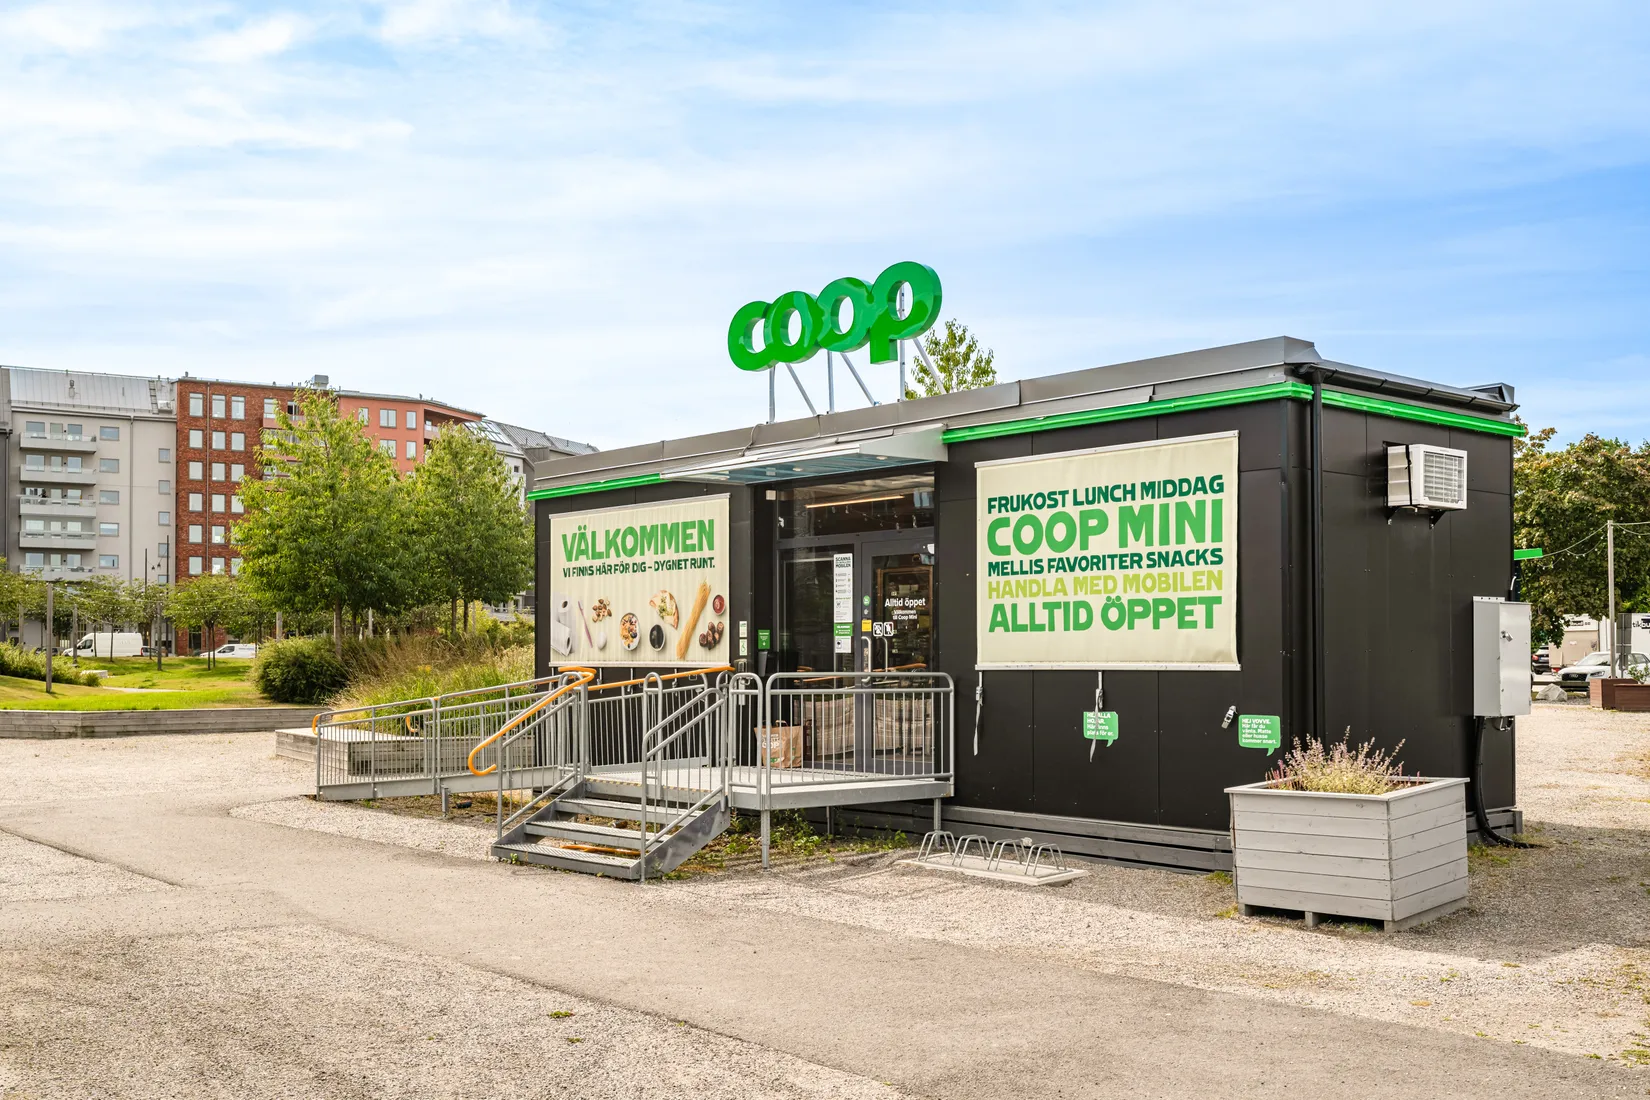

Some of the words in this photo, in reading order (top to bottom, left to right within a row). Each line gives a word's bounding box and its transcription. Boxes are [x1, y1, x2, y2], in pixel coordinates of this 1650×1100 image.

[728, 261, 942, 372] coop
[988, 490, 1069, 514] FRUKOST
[1073, 483, 1136, 507] LUNCH
[1140, 474, 1224, 500] MIDDAG
[561, 519, 715, 562] VÄLKOMMEN
[987, 508, 1109, 556] COOP
[1118, 498, 1223, 548] MINI
[563, 566, 571, 578] VI
[572, 565, 594, 577] FINNS
[595, 562, 612, 576] HÄR
[613, 561, 630, 575] FÖR
[632, 561, 647, 573] DIG
[654, 558, 689, 572] DYGNET
[690, 557, 715, 570] RUNT.
[988, 558, 1044, 577] MELLIS
[1047, 552, 1143, 573] FAVORITER
[1146, 548, 1224, 568] SNACKS
[884, 598, 903, 607] Alltid
[904, 597, 926, 608] öppet
[988, 577, 1068, 599] HANDLA
[1073, 574, 1117, 596] MED
[1122, 570, 1223, 594] MOBILEN
[988, 600, 1093, 632] ALLTID
[1100, 595, 1222, 631] ÖPPET
